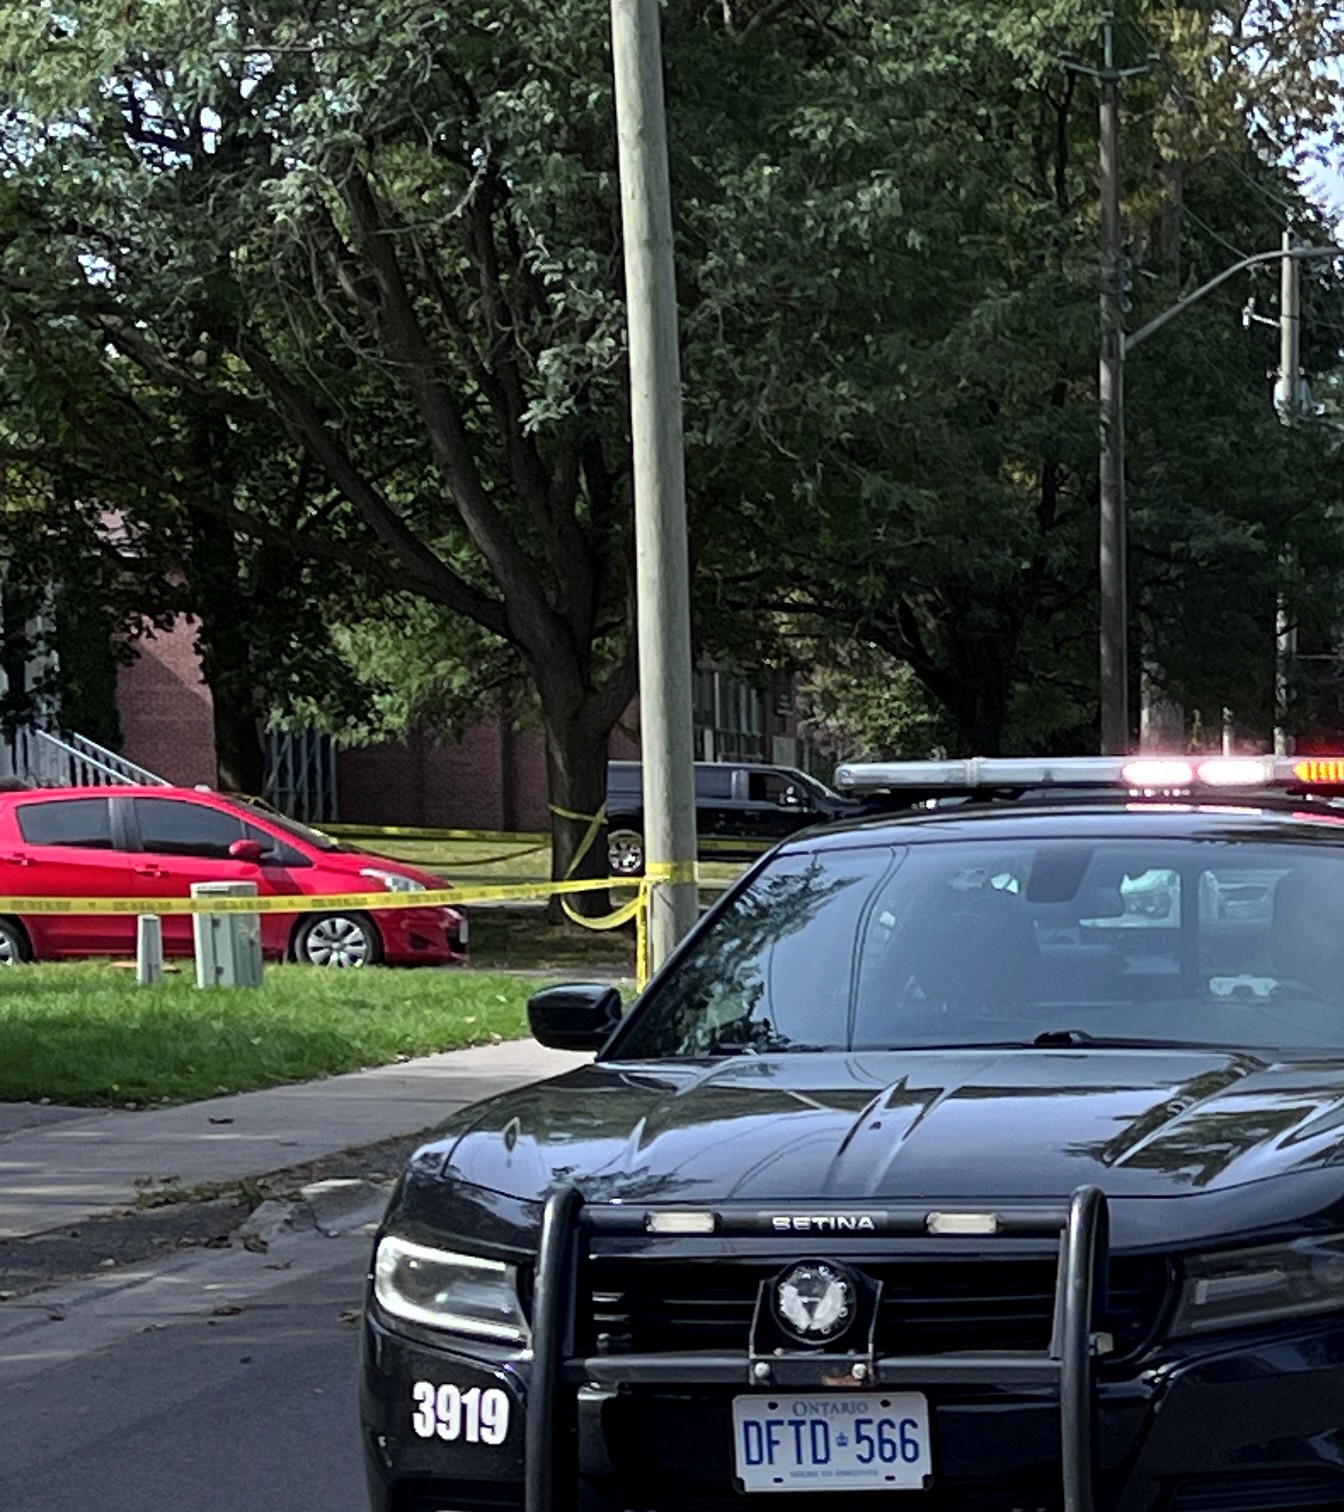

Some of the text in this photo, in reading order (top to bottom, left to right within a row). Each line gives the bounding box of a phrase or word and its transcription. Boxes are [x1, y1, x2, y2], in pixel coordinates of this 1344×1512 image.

[771, 1215, 876, 1231] SETINA
[411, 1380, 510, 1446] 3919
[792, 1400, 869, 1417] ONTARIO
[743, 1417, 920, 1466] DFTD 566
